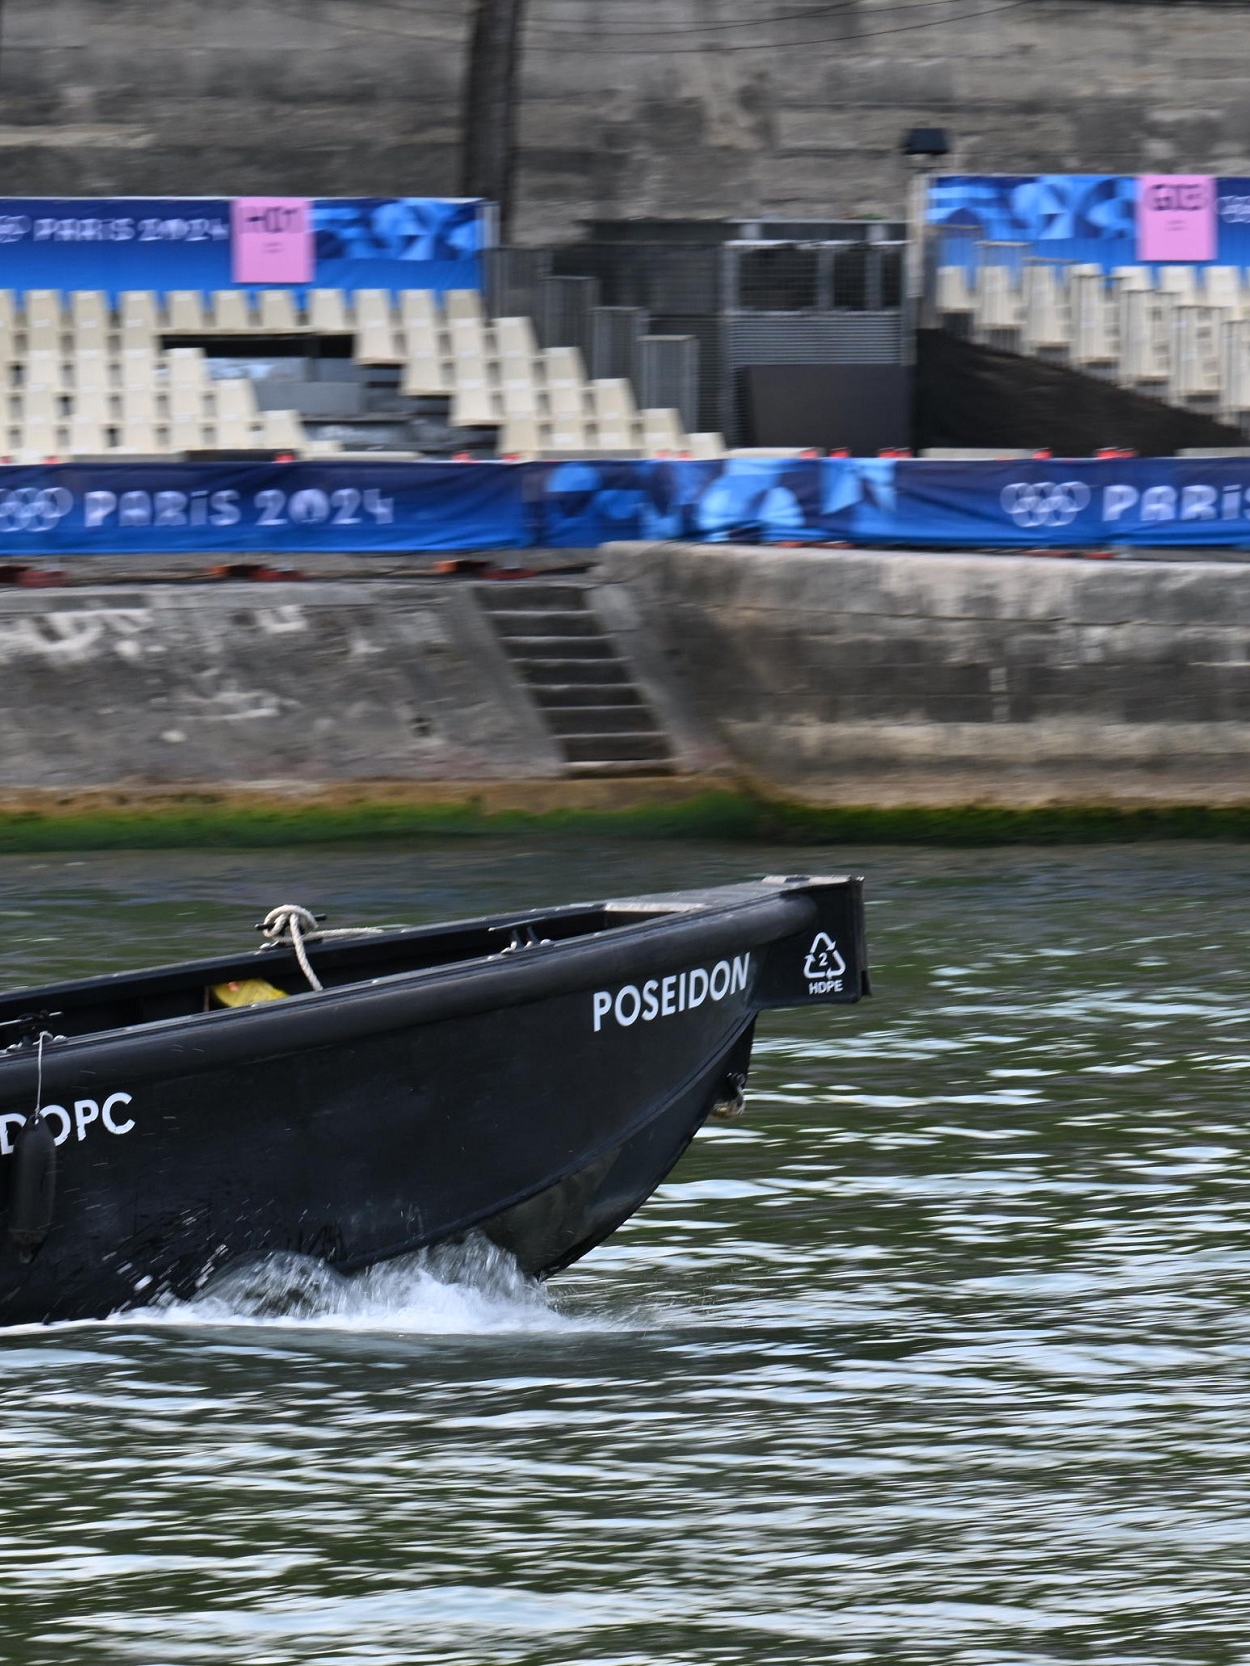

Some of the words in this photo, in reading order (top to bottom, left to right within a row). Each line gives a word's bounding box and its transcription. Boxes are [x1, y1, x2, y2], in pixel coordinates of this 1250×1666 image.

[137, 217, 229, 241] 2024
[253, 488, 395, 526] 2024
[818, 952, 828, 967] 2
[594, 952, 750, 1032] POSEIDON
[808, 979, 844, 995] HDPE
